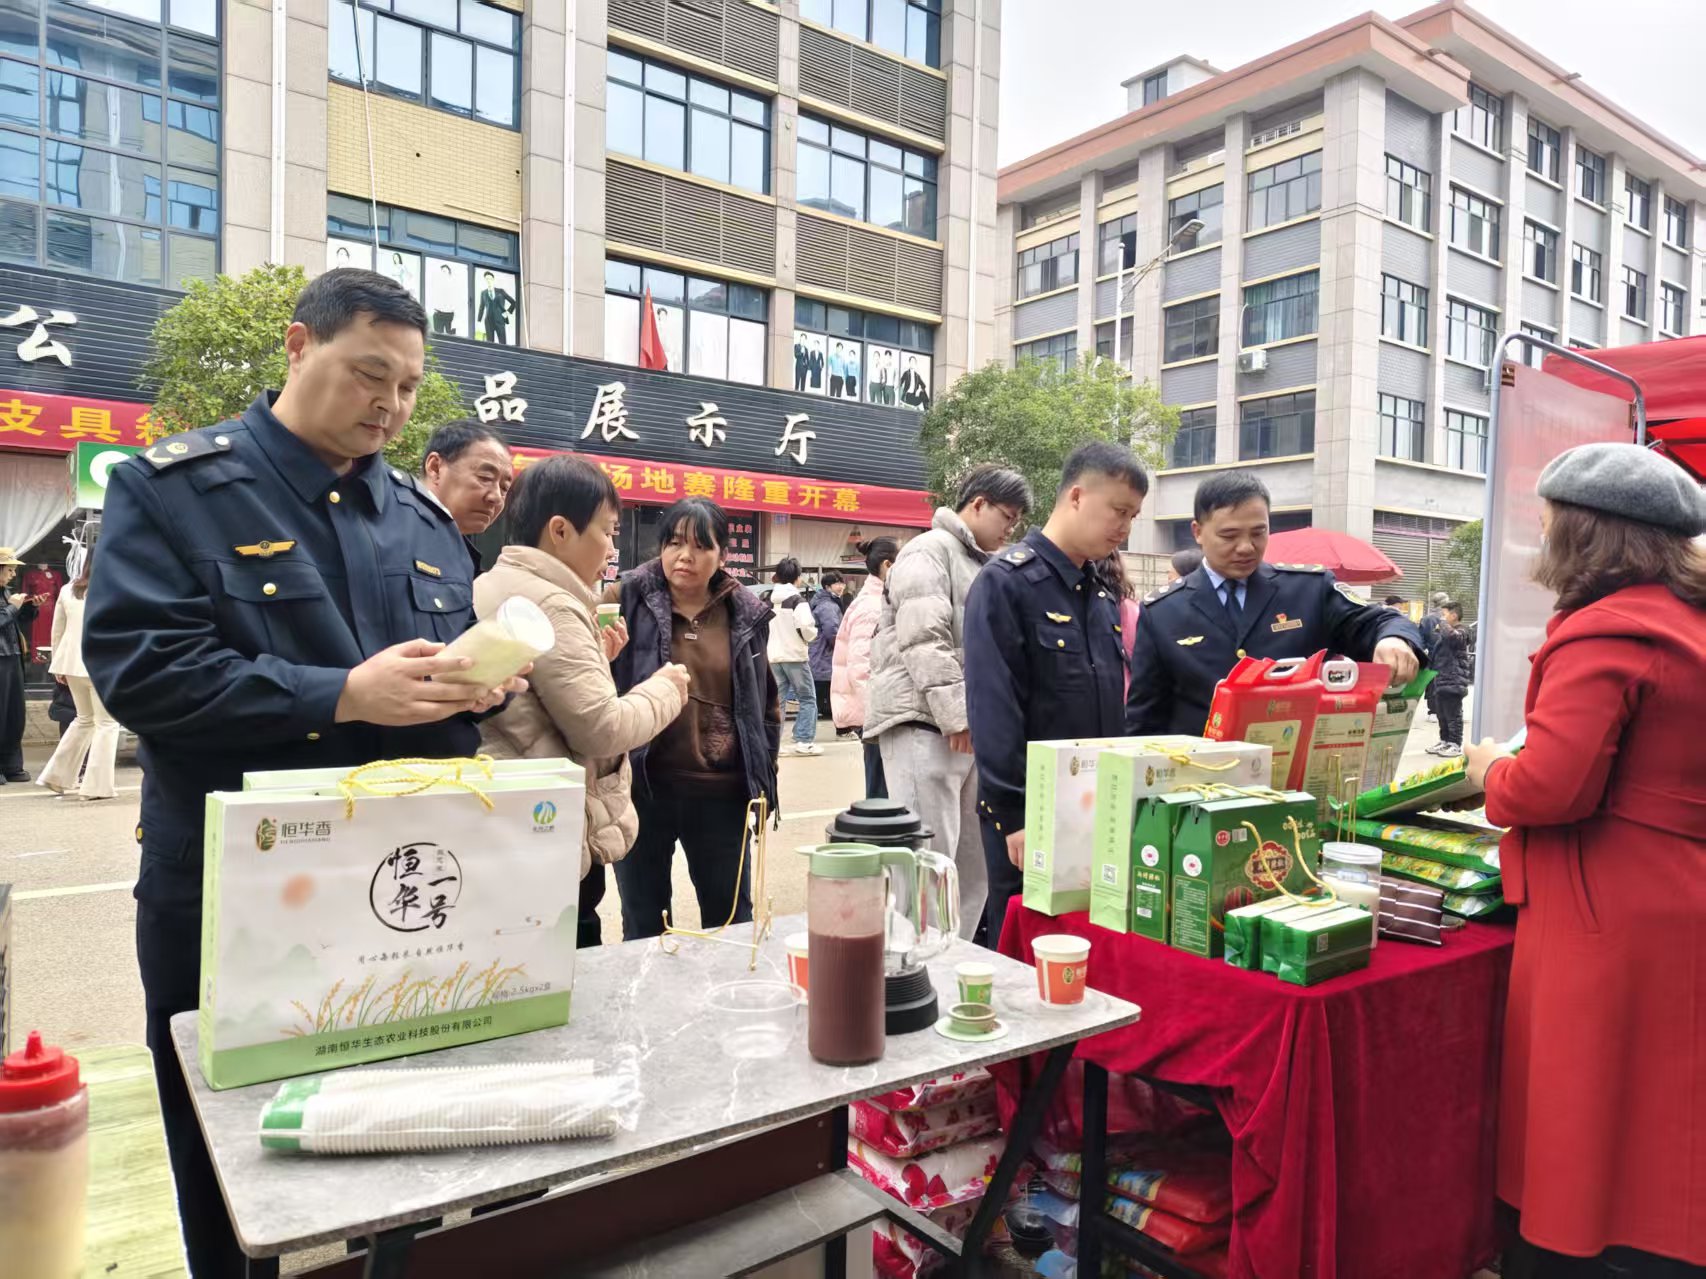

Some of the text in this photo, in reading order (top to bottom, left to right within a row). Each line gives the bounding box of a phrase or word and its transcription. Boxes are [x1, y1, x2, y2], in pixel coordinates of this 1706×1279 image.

[0, 304, 78, 367] 公
[473, 371, 817, 465] 品展示厅
[281, 820, 332, 838] 恒华香
[315, 1015, 493, 1057] 湖南恒华生态农业科技股份有限公司
